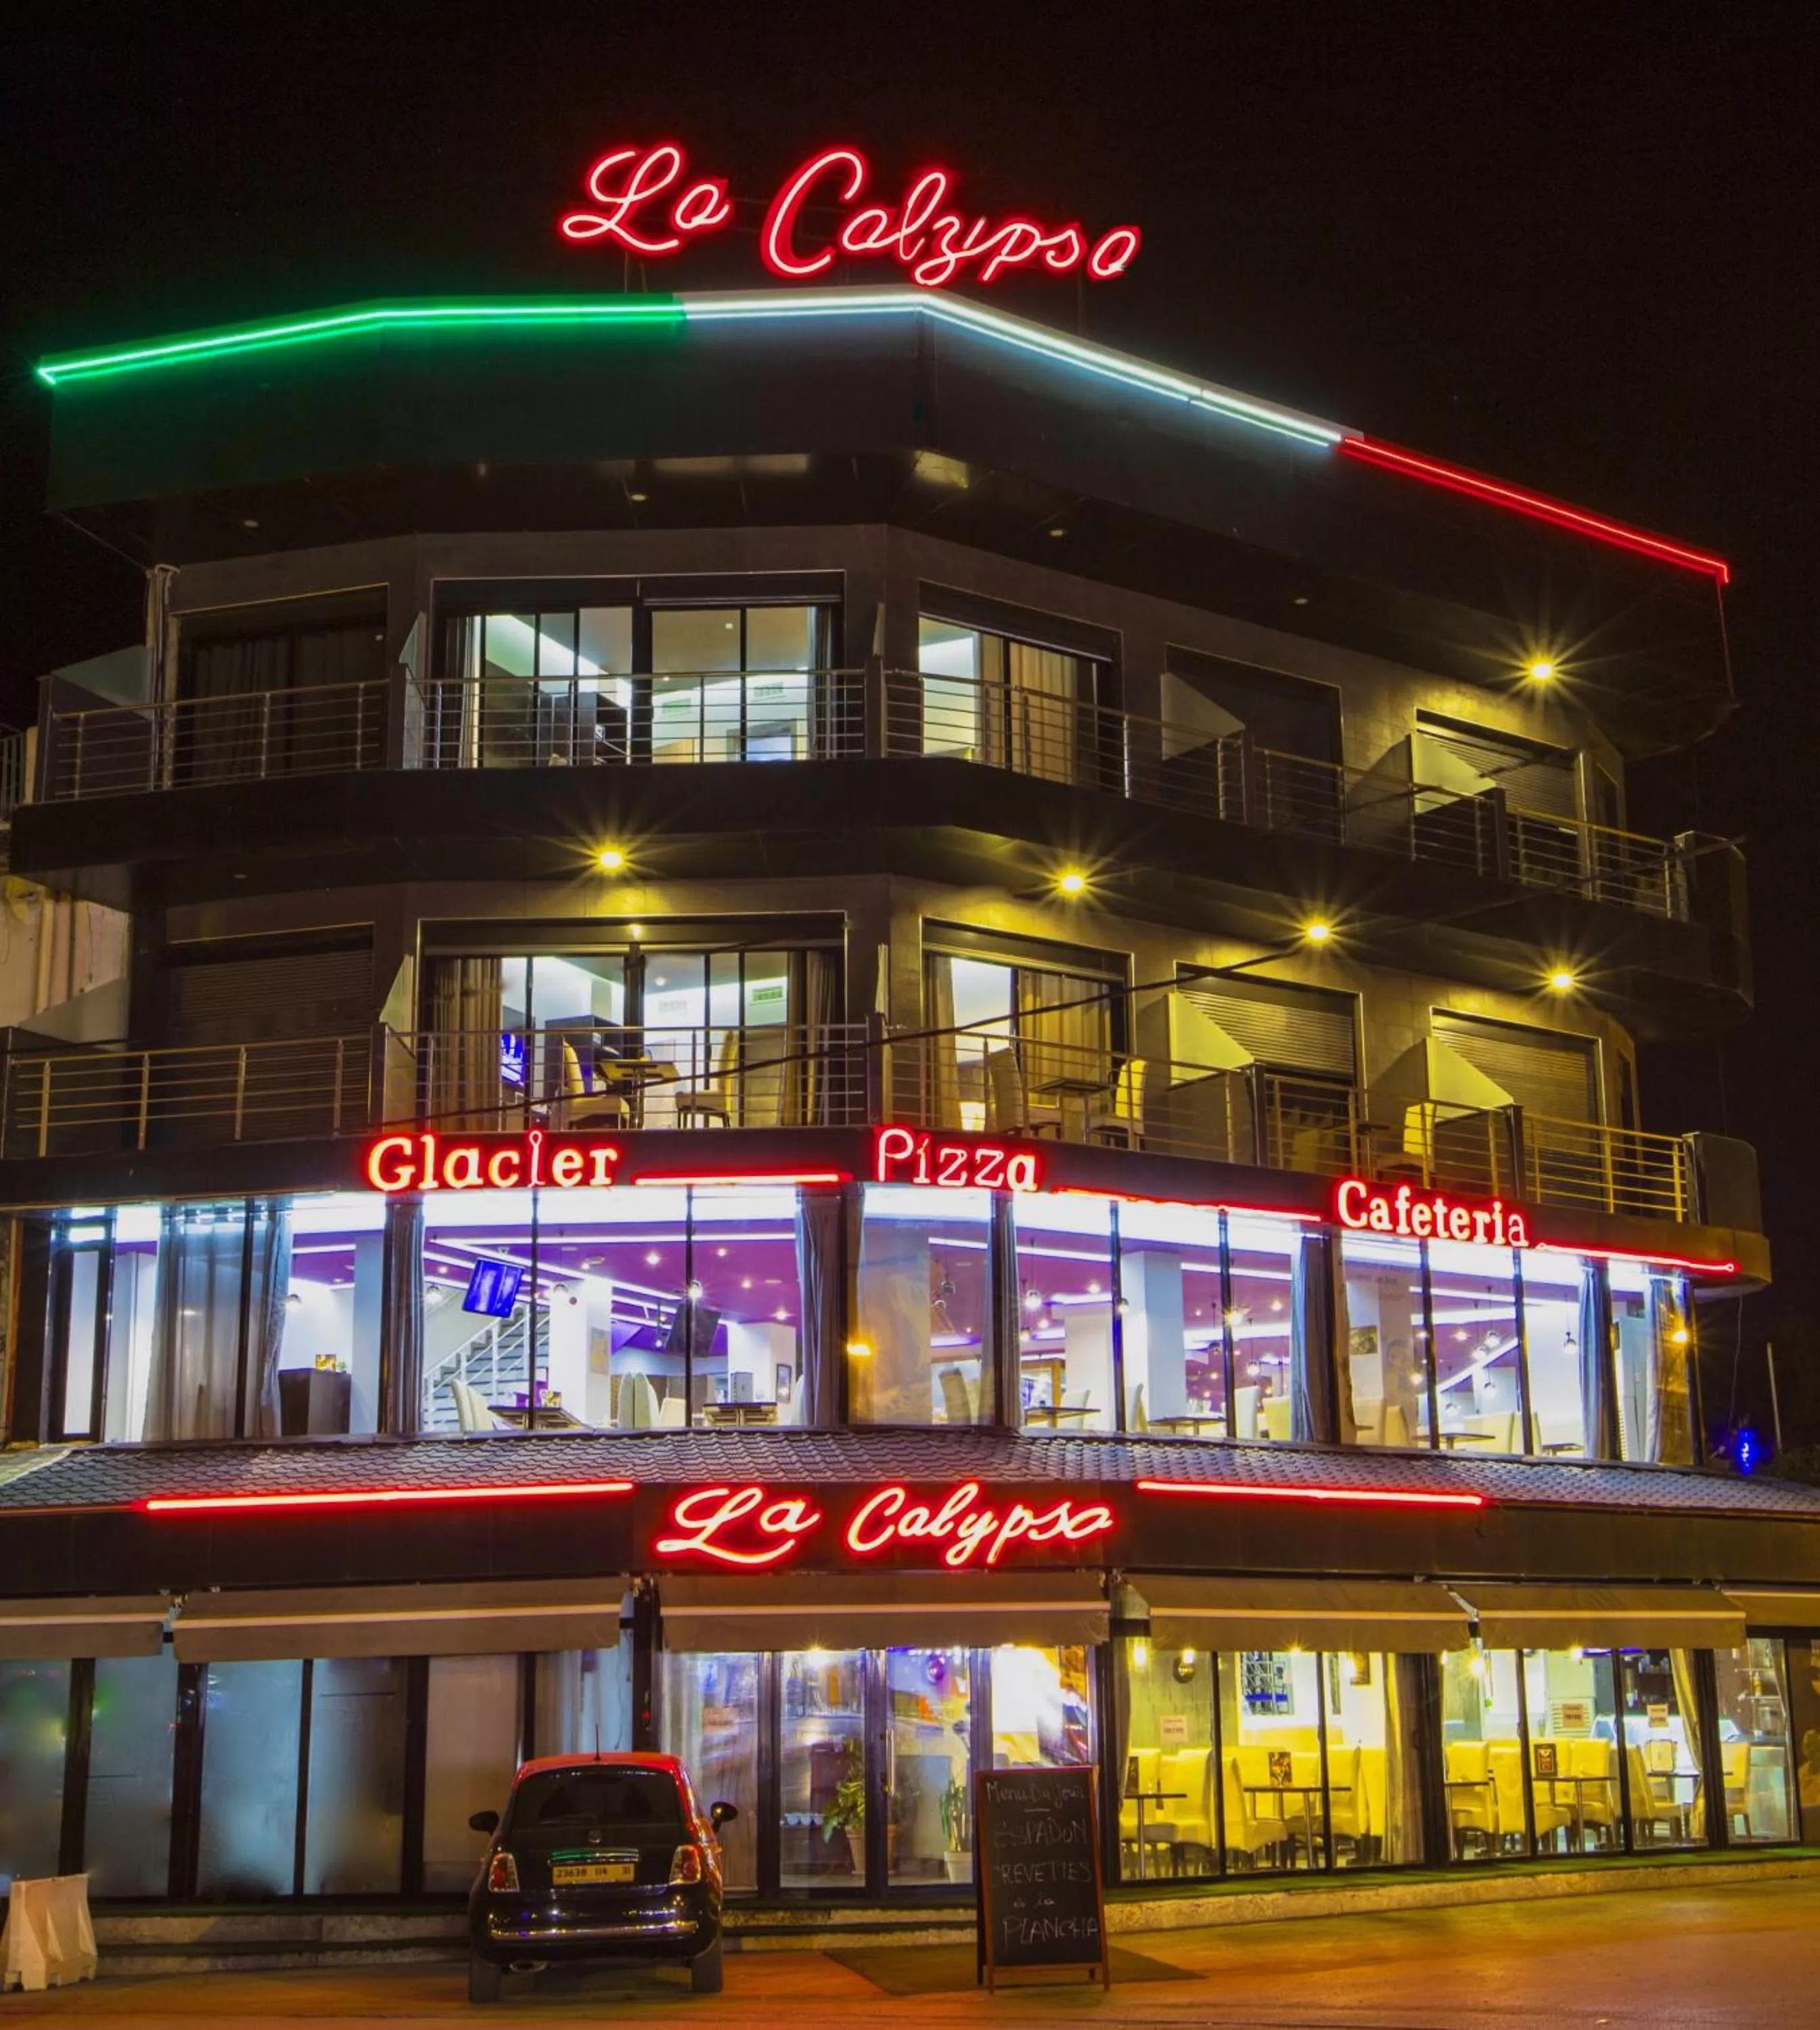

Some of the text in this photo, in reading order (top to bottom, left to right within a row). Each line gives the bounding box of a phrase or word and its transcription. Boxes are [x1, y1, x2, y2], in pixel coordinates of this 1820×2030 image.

[561, 145, 1141, 288] La Calypso
[367, 1129, 619, 1192] Glacier
[877, 1127, 1039, 1192] Pizza
[1337, 1179, 1530, 1248] Cafeteria
[655, 1482, 1114, 1566] La Calypso
